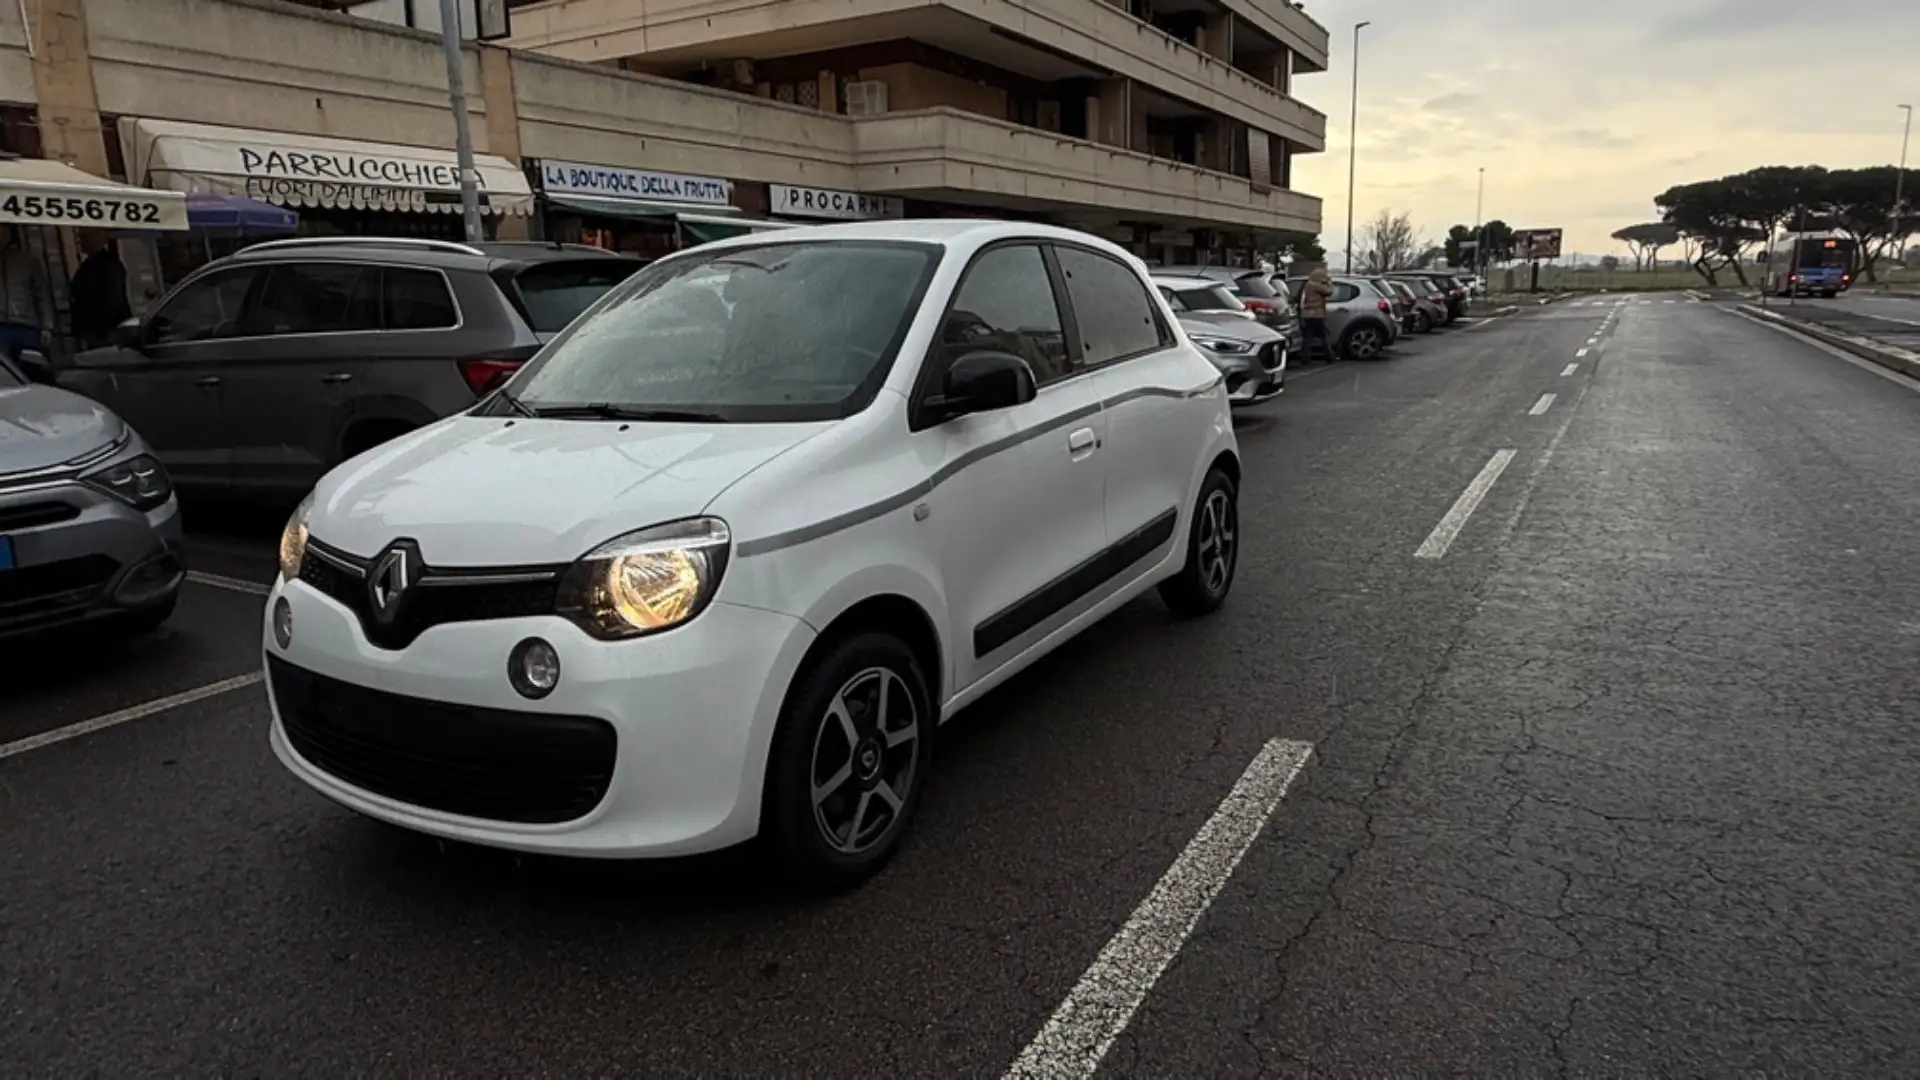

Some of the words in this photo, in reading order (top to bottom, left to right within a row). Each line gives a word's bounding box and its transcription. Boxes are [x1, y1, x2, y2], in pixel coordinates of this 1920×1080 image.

[546, 166, 566, 185] LA
[570, 168, 639, 193] BOUTIQUE
[641, 176, 681, 196] DELLA
[684, 179, 725, 199] FRUTTA
[2, 195, 160, 224] 45556782
